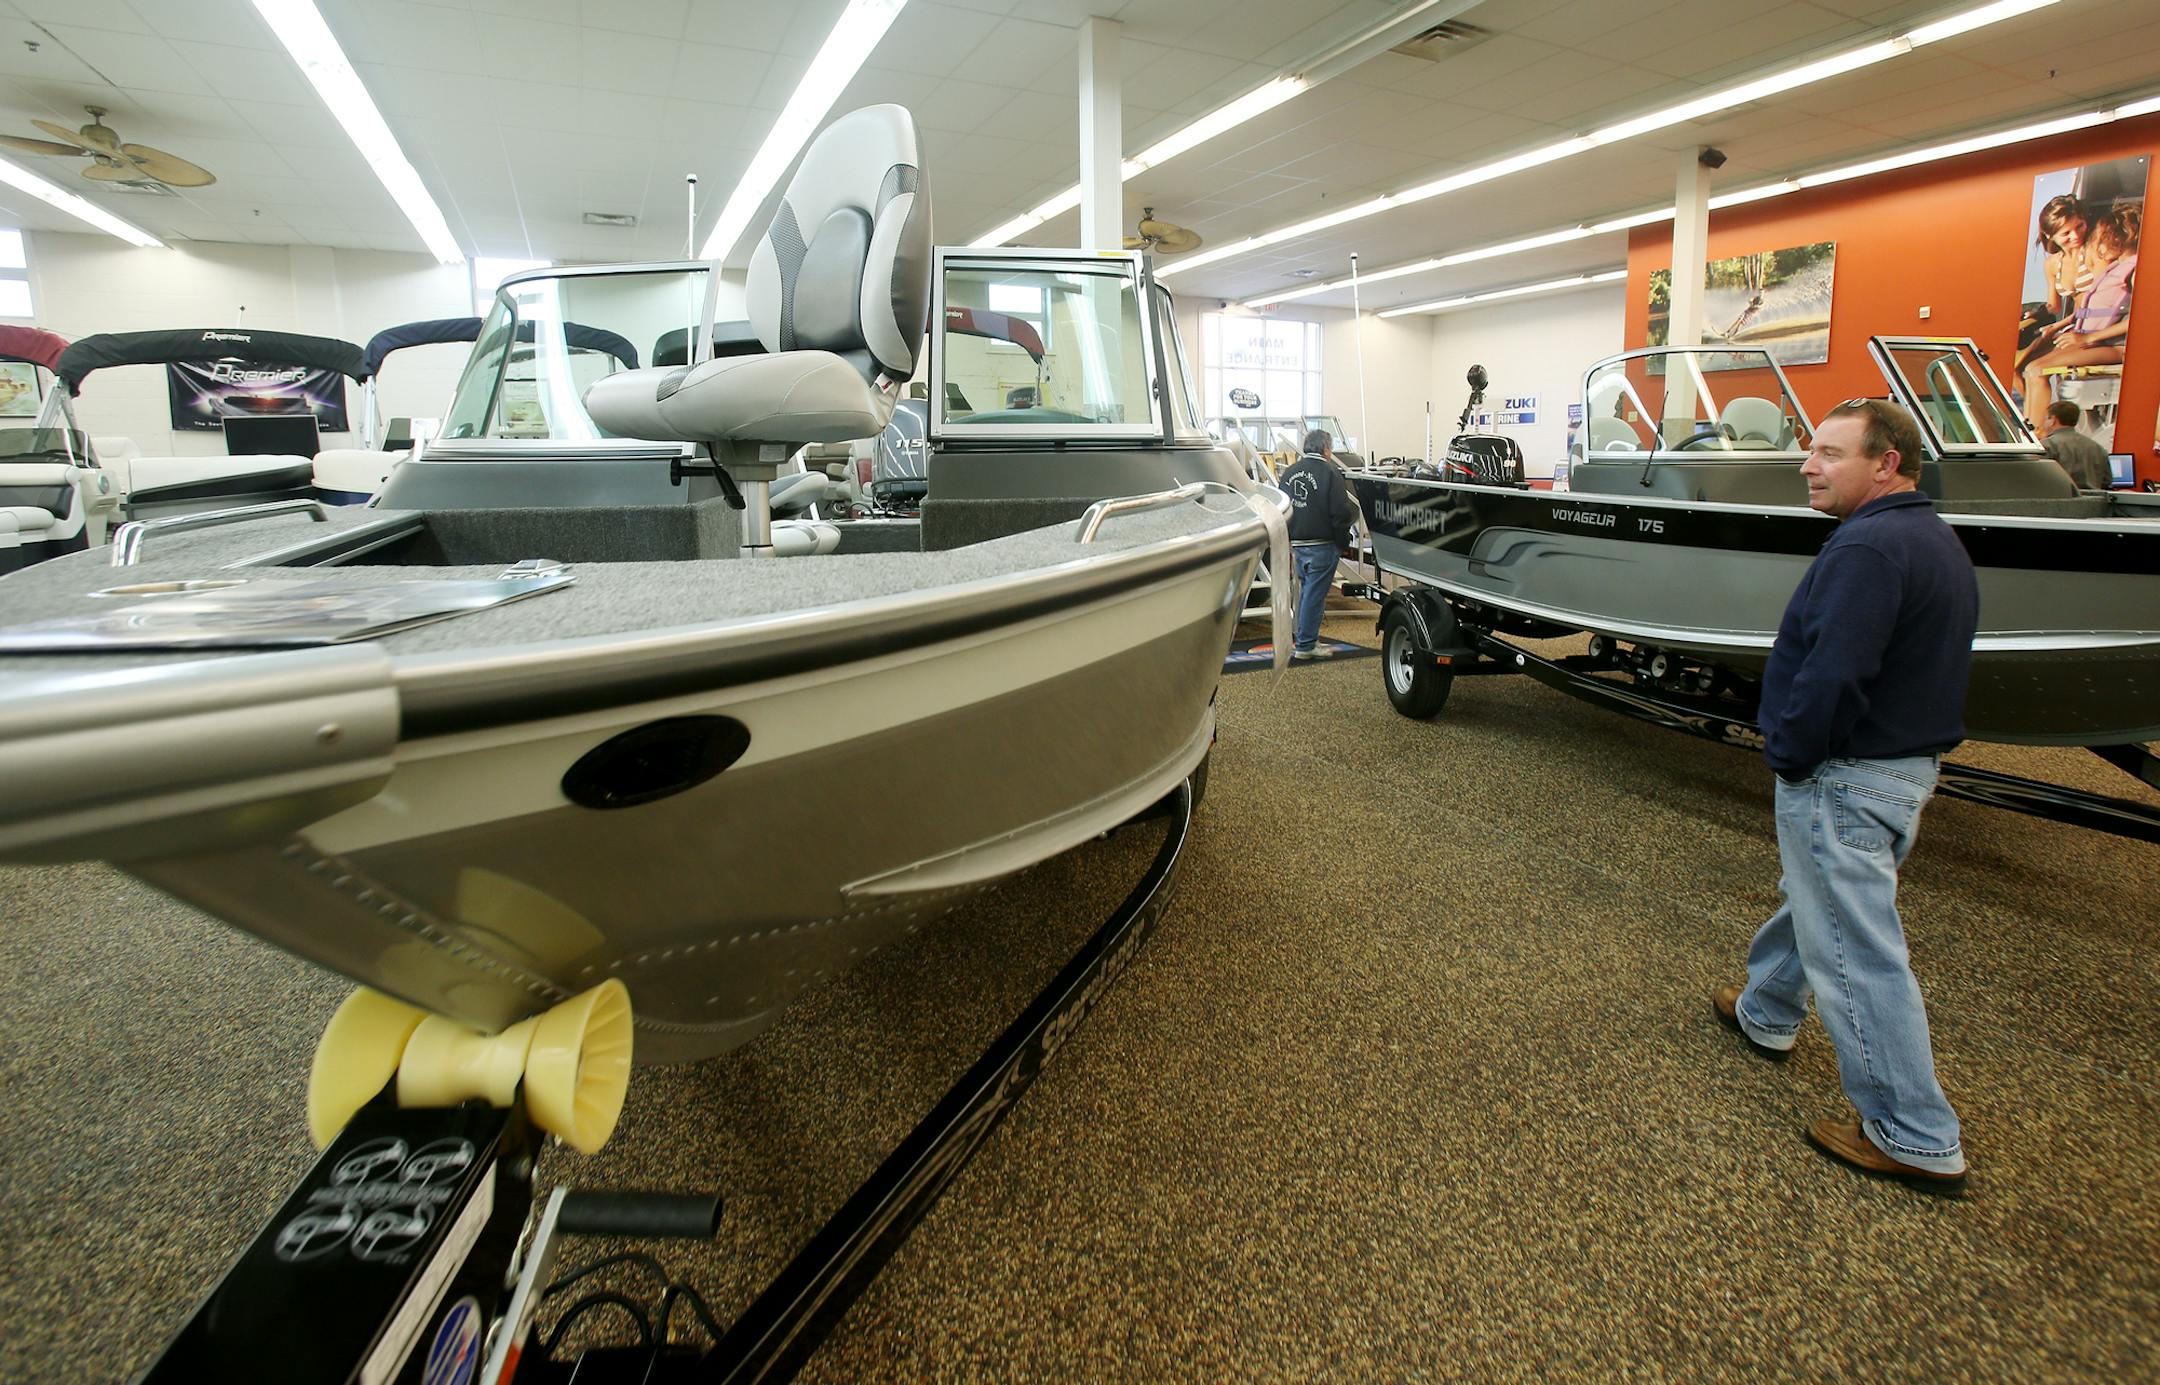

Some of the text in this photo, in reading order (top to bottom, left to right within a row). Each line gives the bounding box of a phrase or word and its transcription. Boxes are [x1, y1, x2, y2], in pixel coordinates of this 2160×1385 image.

[202, 332, 251, 343] Premier
[211, 363, 307, 386] Premier
[1505, 397, 1536, 409] ZUKI
[1484, 413, 1520, 425] MRINE
[1375, 500, 1448, 534] ALUMACRAFT
[1552, 508, 1664, 534] VOYAGEUR 175
